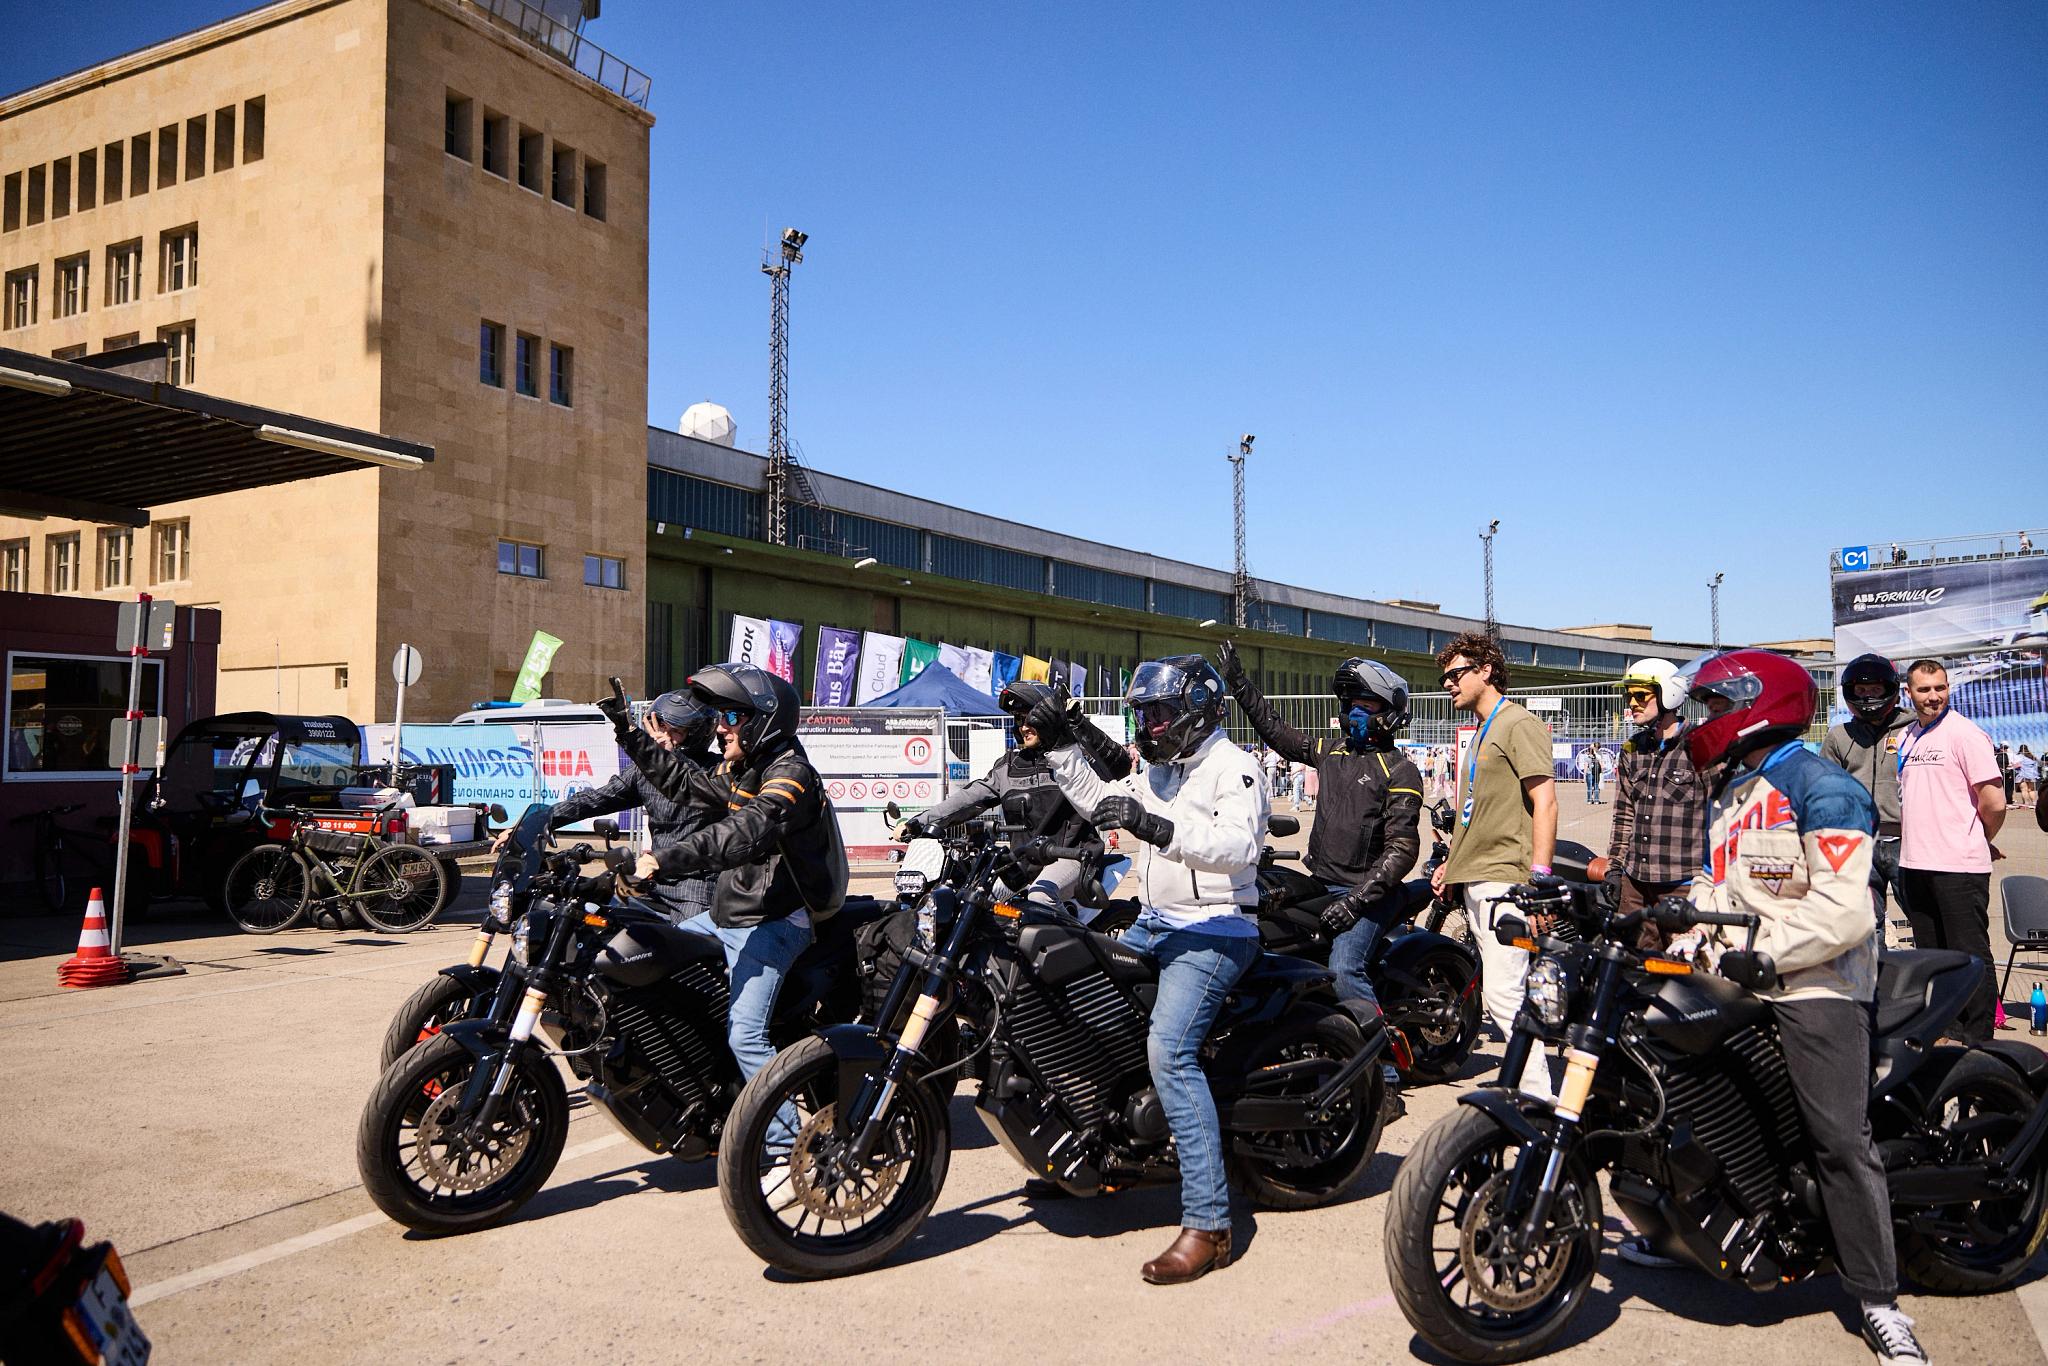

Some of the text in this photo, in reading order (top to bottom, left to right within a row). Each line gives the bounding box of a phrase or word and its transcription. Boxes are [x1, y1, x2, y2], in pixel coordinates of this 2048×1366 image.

[1844, 551, 1867, 566] C1
[1853, 593, 1875, 603] ABB
[1875, 589, 1927, 603] FORMULA
[827, 638, 848, 676] Bär
[871, 653, 887, 693] Cloud
[303, 720, 333, 729] mateco
[806, 715, 851, 725] CAUTION
[832, 727, 859, 735] assembly
[912, 745, 925, 757] 10
[620, 952, 653, 964] LiveWire
[1112, 953, 1138, 965] LiveWire
